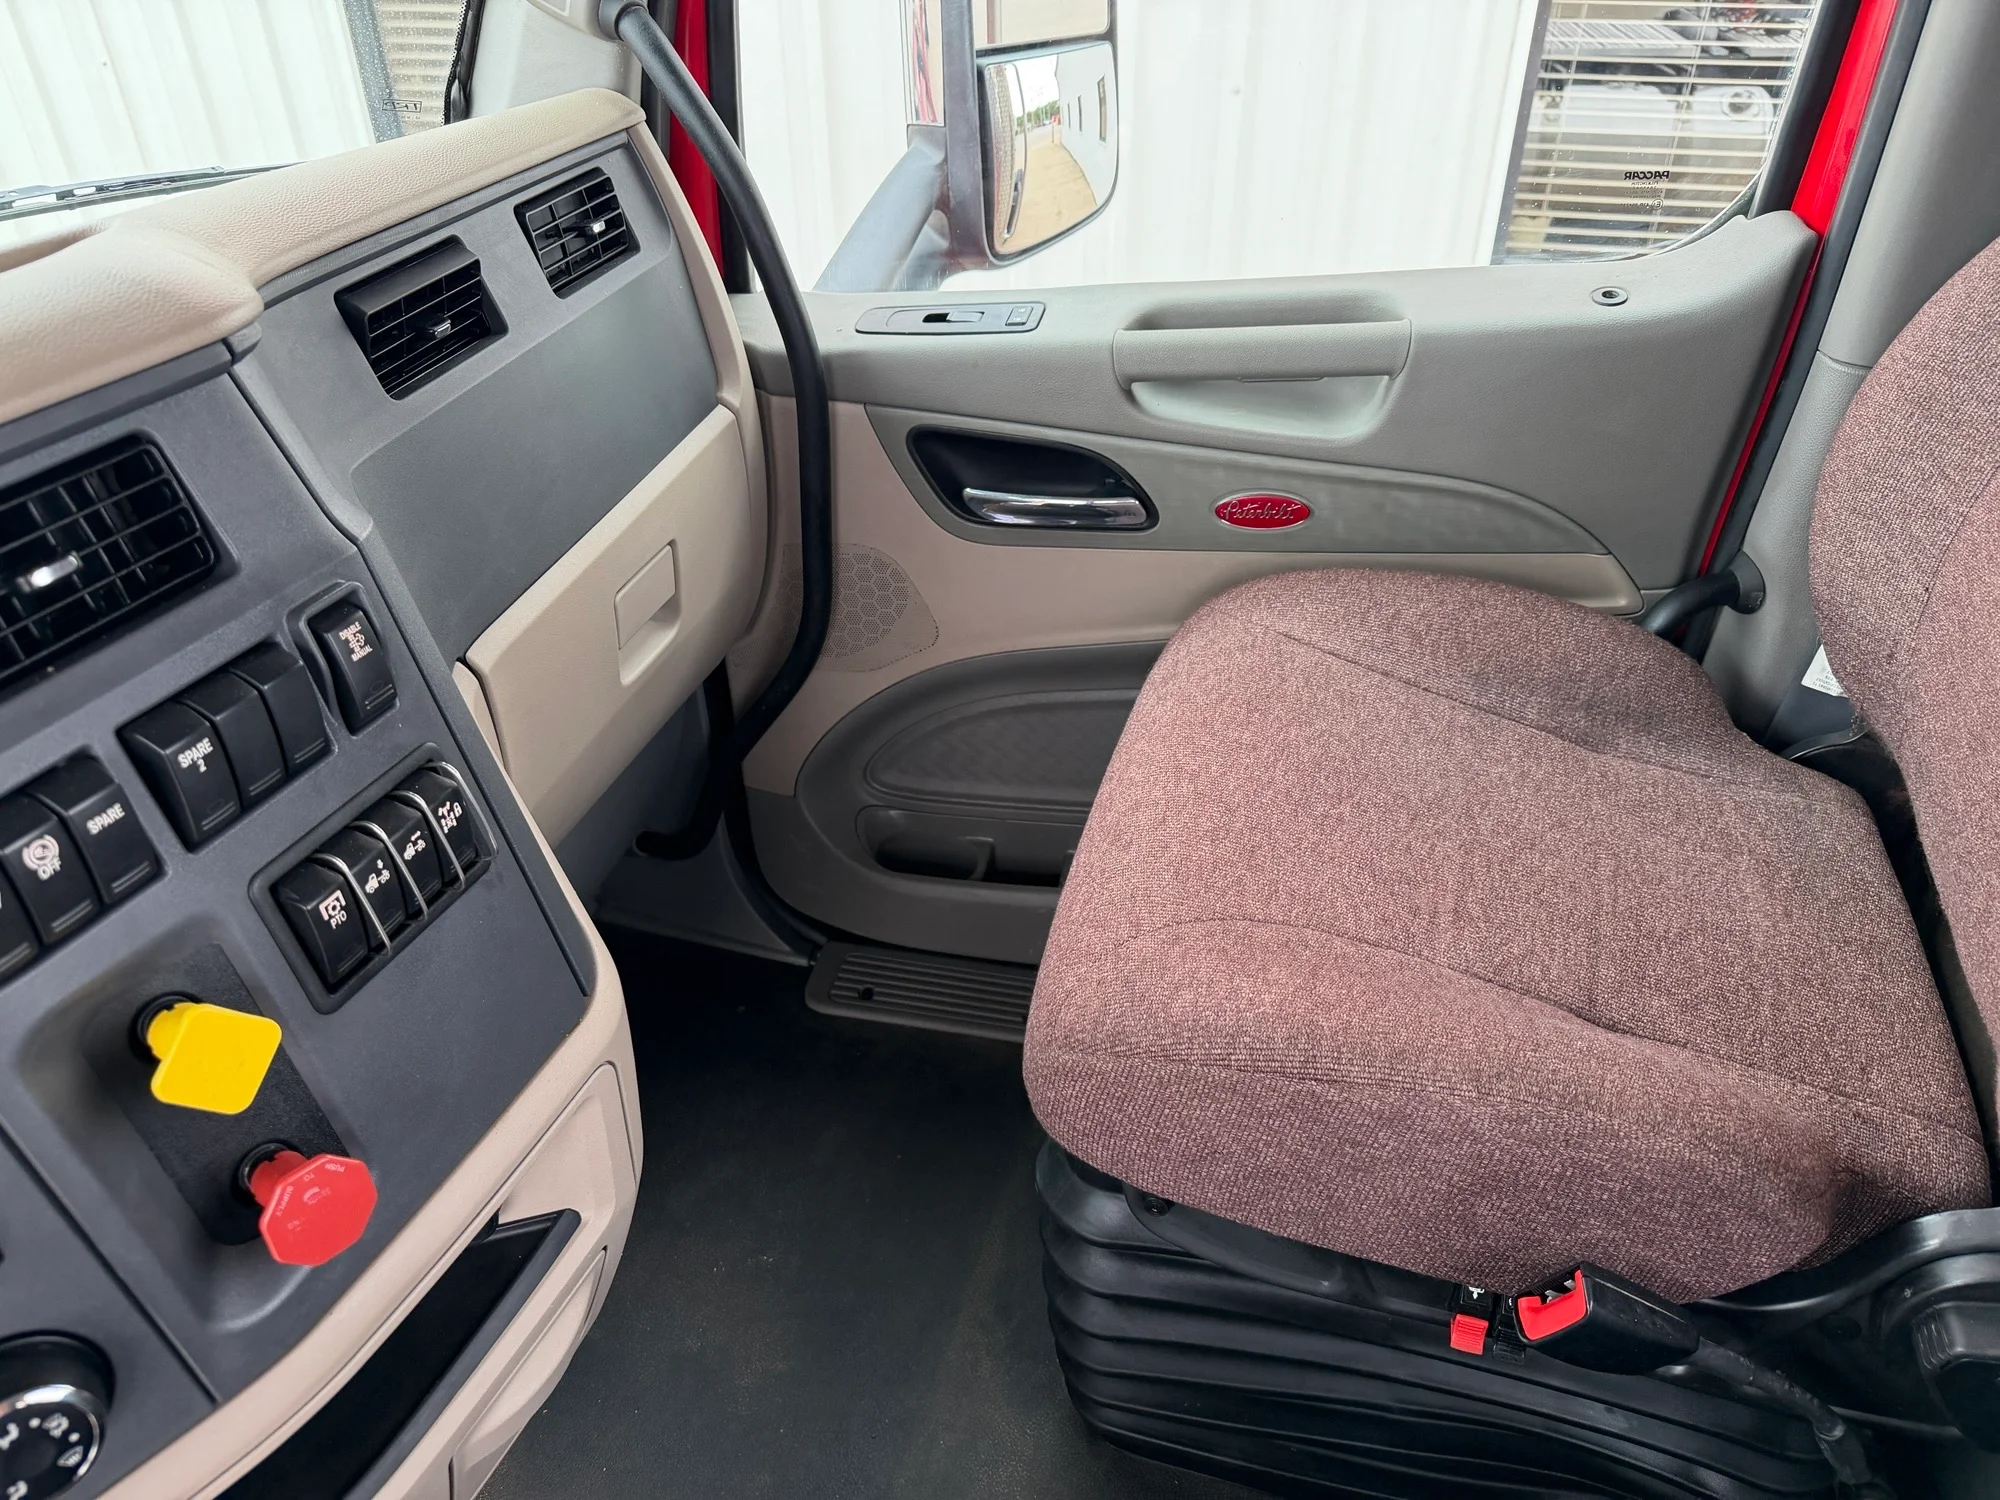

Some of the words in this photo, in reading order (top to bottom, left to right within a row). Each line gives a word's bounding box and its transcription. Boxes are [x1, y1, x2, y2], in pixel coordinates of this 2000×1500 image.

[1220, 500, 1302, 520] Peterbilt
[339, 621, 361, 640] DISABLE
[351, 644, 373, 662] MANUAL
[177, 737, 213, 768] SPARE
[197, 758, 207, 773] 2
[86, 802, 125, 835] SPARE
[37, 856, 61, 880] OFF
[330, 910, 347, 929] PTO
[303, 1172, 316, 1182] TO
[325, 1163, 345, 1173] PUSH
[276, 1185, 294, 1216] SUPPLY
